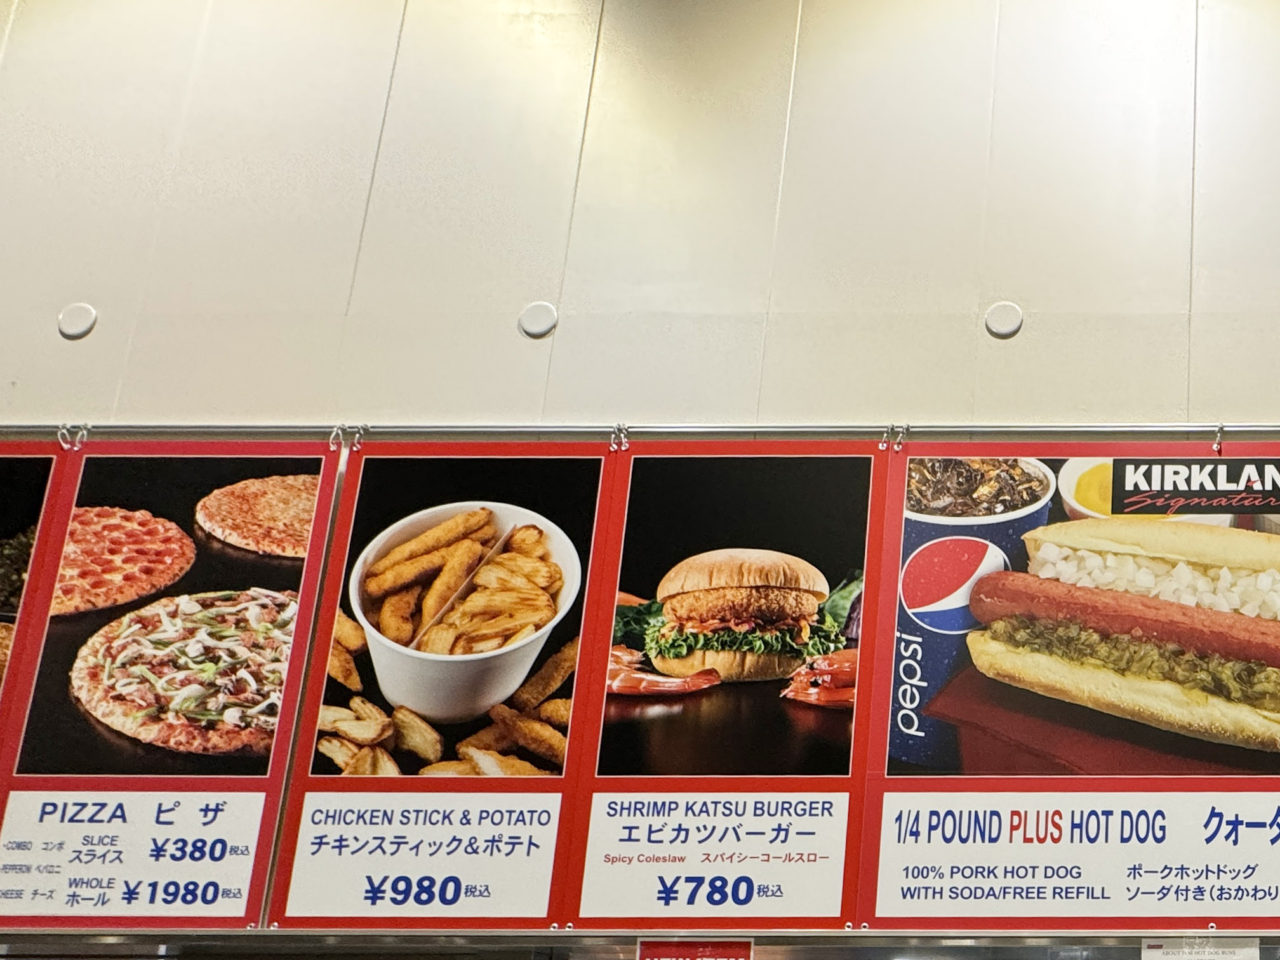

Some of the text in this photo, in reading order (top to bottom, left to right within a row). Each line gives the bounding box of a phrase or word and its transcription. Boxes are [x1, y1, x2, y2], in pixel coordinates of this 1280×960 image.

[896, 631, 928, 737] pepsi
[39, 803, 127, 823] PIZZA
[607, 801, 833, 817] SHRIMP KATSU BURGER
[311, 809, 551, 826] CHICKEN STICK & POTATO
[619, 823, 815, 844] エビカツバーガー
[895, 810, 1166, 844] 1/4 POUND PLUS HOT DOG
[82, 835, 119, 846] SLICE
[69, 849, 123, 864] スライス
[150, 838, 249, 861] ¥380 税込
[604, 854, 686, 865] Spicy Coleslaw
[701, 853, 829, 863] スパイシーコールスロー
[903, 866, 1081, 879] 100% PORK HOT DOG
[1127, 864, 1258, 880] ポークホットドッグ
[69, 878, 116, 889] WHOLE
[364, 876, 490, 905] ¥980 税込
[657, 876, 783, 906] ¥780 税込
[31, 889, 56, 900] チーズ
[66, 891, 110, 907] ホール
[122, 881, 242, 904] ¥1980 税込
[901, 887, 1110, 899] WITH SODA/FREE REFILL
